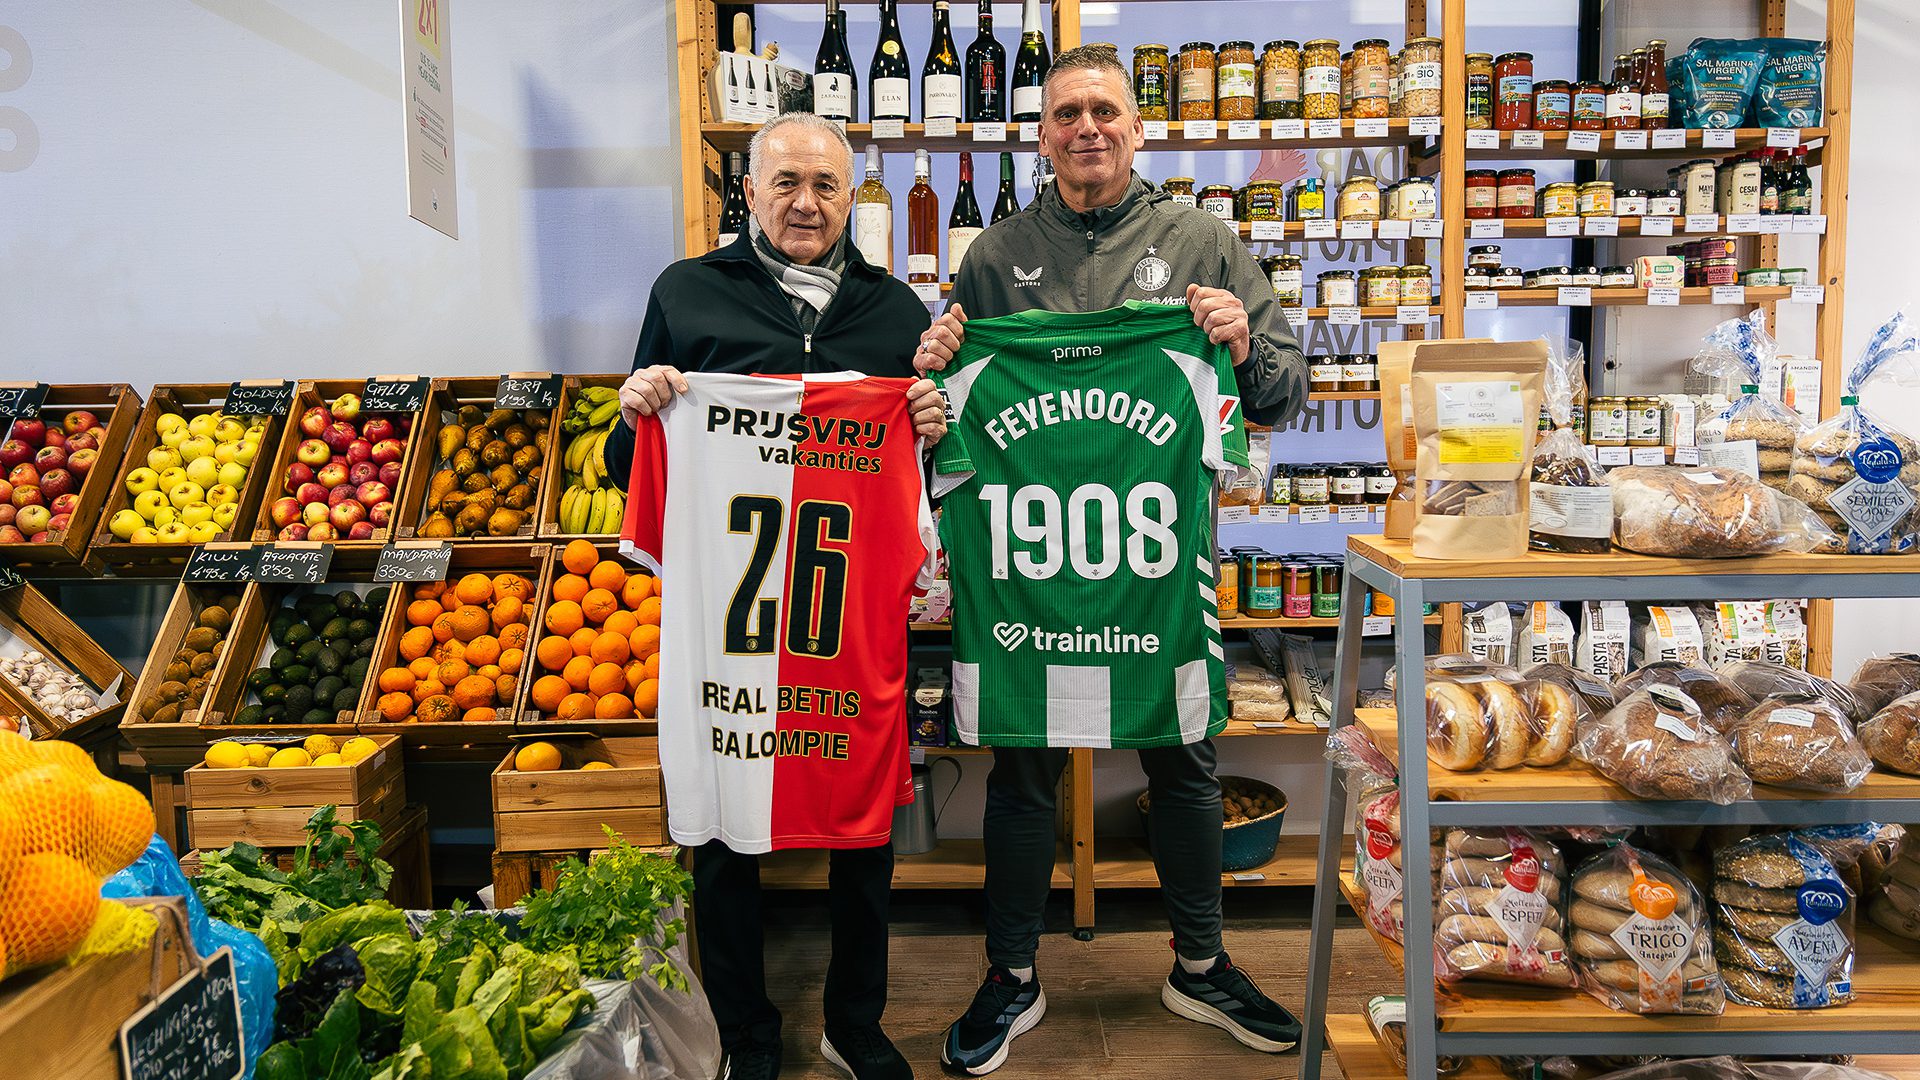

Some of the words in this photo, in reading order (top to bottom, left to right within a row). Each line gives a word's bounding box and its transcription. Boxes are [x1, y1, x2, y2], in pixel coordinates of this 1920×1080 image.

[1695, 59, 1714, 68] SAL
[1716, 60, 1754, 69] MARINA
[1706, 67, 1743, 75] VIRGEN
[1775, 62, 1811, 74] VIRGEN
[1206, 203, 1224, 213] BIO
[1050, 344, 1103, 362] prima
[232, 387, 291, 400] GOLDEN
[366, 383, 411, 396] GALA
[984, 387, 1178, 451] FEYENOORD
[757, 445, 882, 474] vakanties
[1846, 494, 1905, 507] SEMILLAS
[978, 481, 1179, 580] 1908
[261, 551, 324, 564] AGUACATE
[722, 493, 854, 660] 26
[1032, 625, 1160, 654] trainline
[1593, 642, 1609, 676] PASTA
[701, 680, 768, 715] REAL
[776, 685, 861, 718] BETIS
[1626, 930, 1688, 949] TRIGO
[1787, 935, 1839, 955] AVENA
